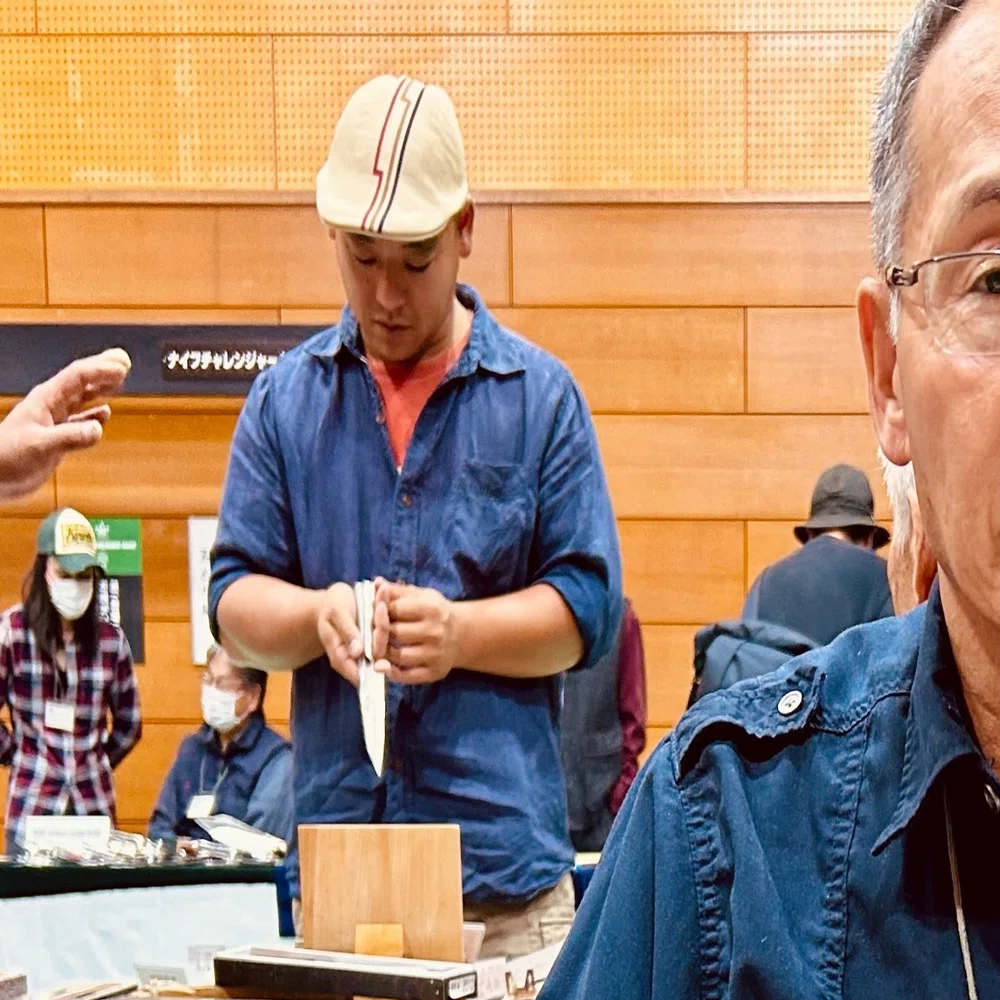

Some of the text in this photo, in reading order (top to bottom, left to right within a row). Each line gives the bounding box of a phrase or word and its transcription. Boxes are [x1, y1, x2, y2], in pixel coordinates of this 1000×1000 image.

[166, 349, 285, 371] ナイフチャレンジャー
